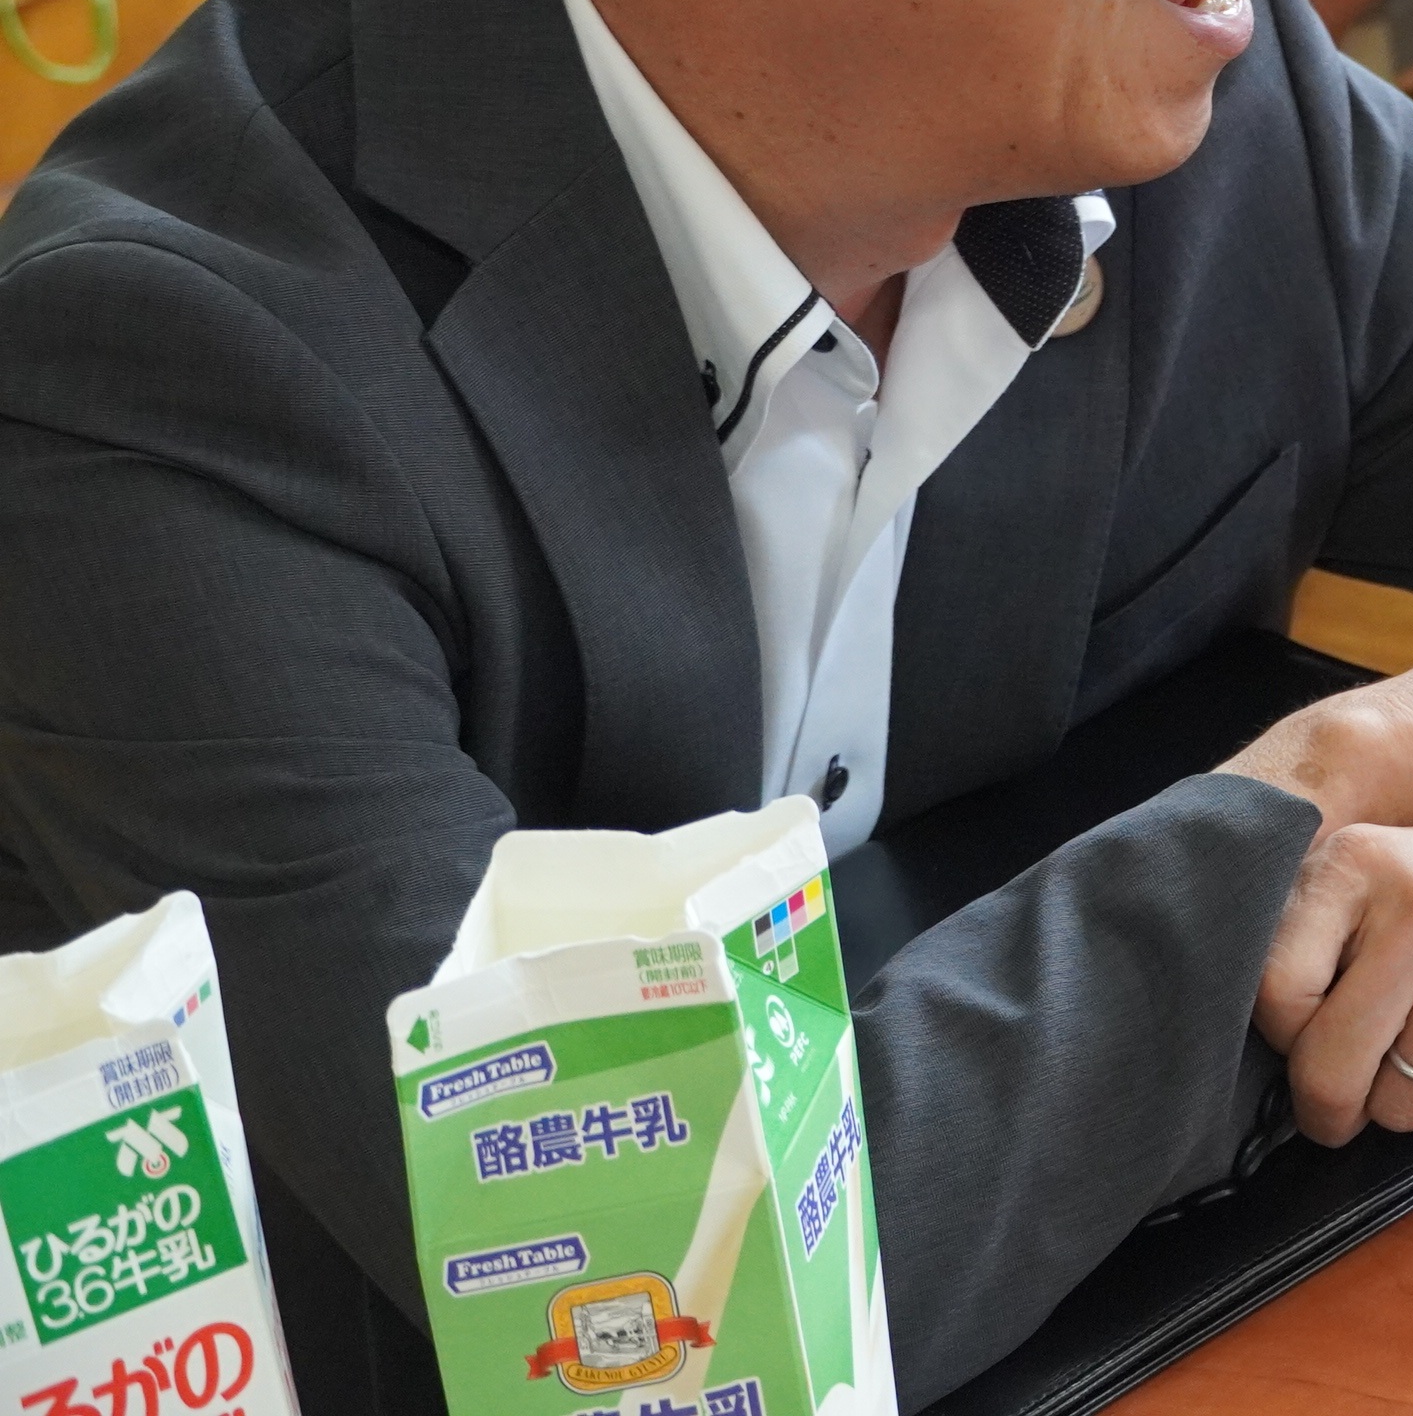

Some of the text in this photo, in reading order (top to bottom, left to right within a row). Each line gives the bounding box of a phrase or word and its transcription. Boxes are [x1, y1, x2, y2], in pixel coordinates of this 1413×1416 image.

[100, 1040, 174, 1084] 賞味期限
[789, 1030, 811, 1067] PEFC
[429, 1070, 486, 1102] Fresh
[486, 1052, 543, 1081] Table
[473, 1094, 688, 1181] 酪農牛乳
[797, 1100, 862, 1258] 酪農牛乳
[20, 1184, 201, 1283] ひるがの
[455, 1253, 518, 1280] Fresh
[517, 1242, 576, 1268] Table
